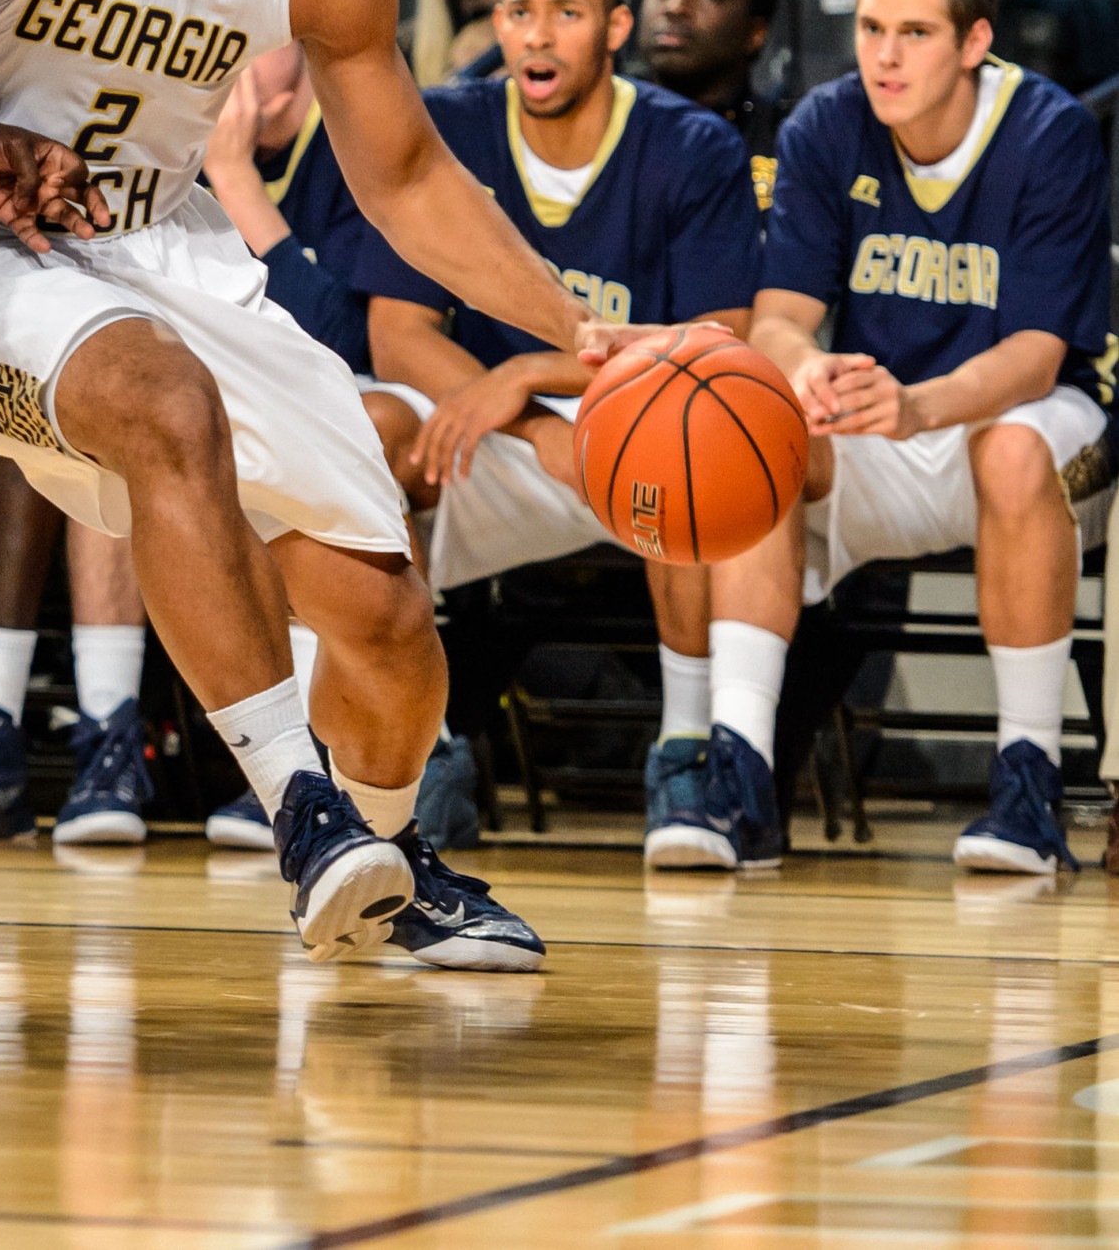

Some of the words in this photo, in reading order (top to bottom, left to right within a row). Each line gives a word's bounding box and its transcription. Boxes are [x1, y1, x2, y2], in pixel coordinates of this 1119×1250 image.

[72, 88, 143, 162] 2
[849, 233, 1000, 310] GEORGIA
[633, 480, 665, 558] ELITE
